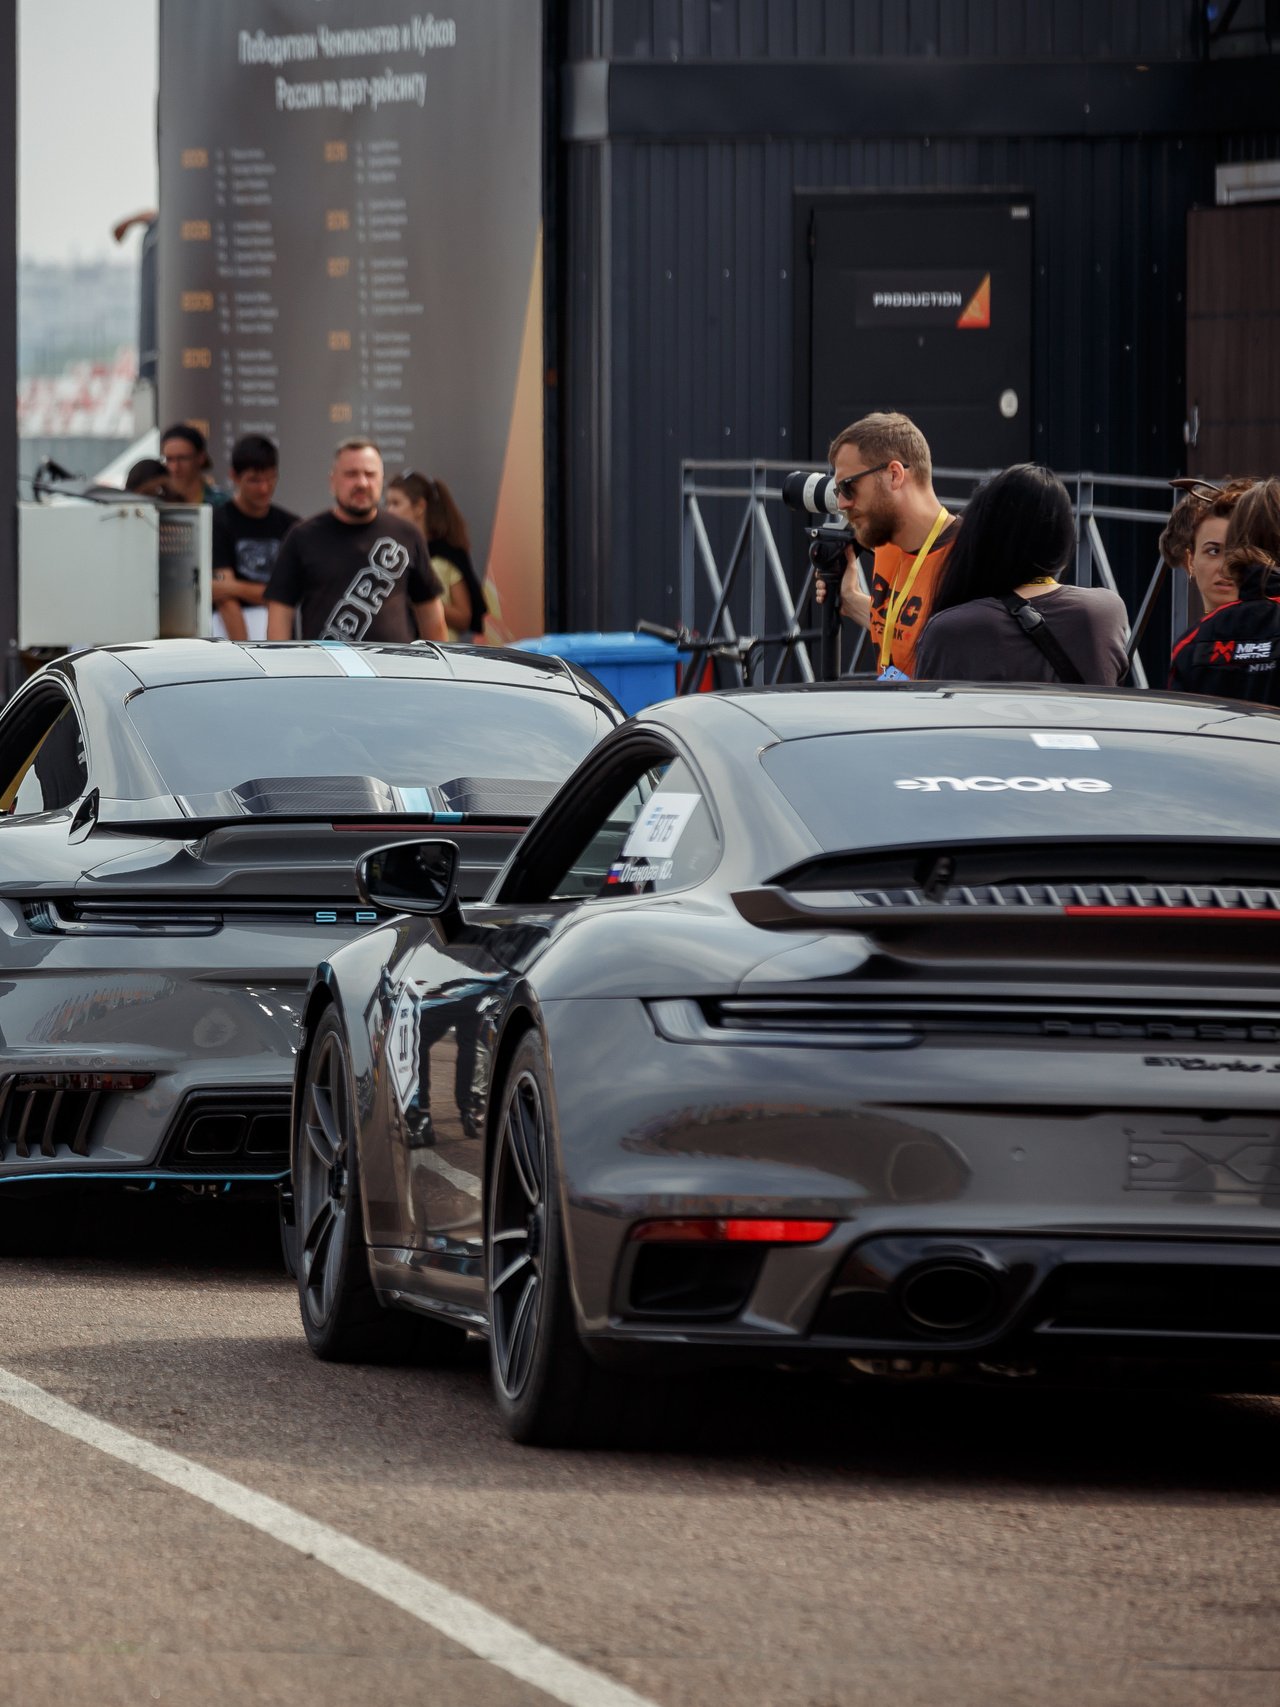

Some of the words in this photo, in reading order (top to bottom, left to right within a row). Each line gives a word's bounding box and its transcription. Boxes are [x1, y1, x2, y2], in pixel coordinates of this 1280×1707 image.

[238, 29, 318, 66] Победители
[318, 24, 400, 58] Чемпионатов
[401, 24, 411, 50] и
[411, 13, 456, 57] Кубков
[276, 76, 321, 111] России
[323, 80, 338, 107] по
[873, 291, 962, 308] PRODUCTION
[320, 536, 410, 641] DRC
[892, 775, 1113, 793] encore
[315, 911, 377, 923] SP
